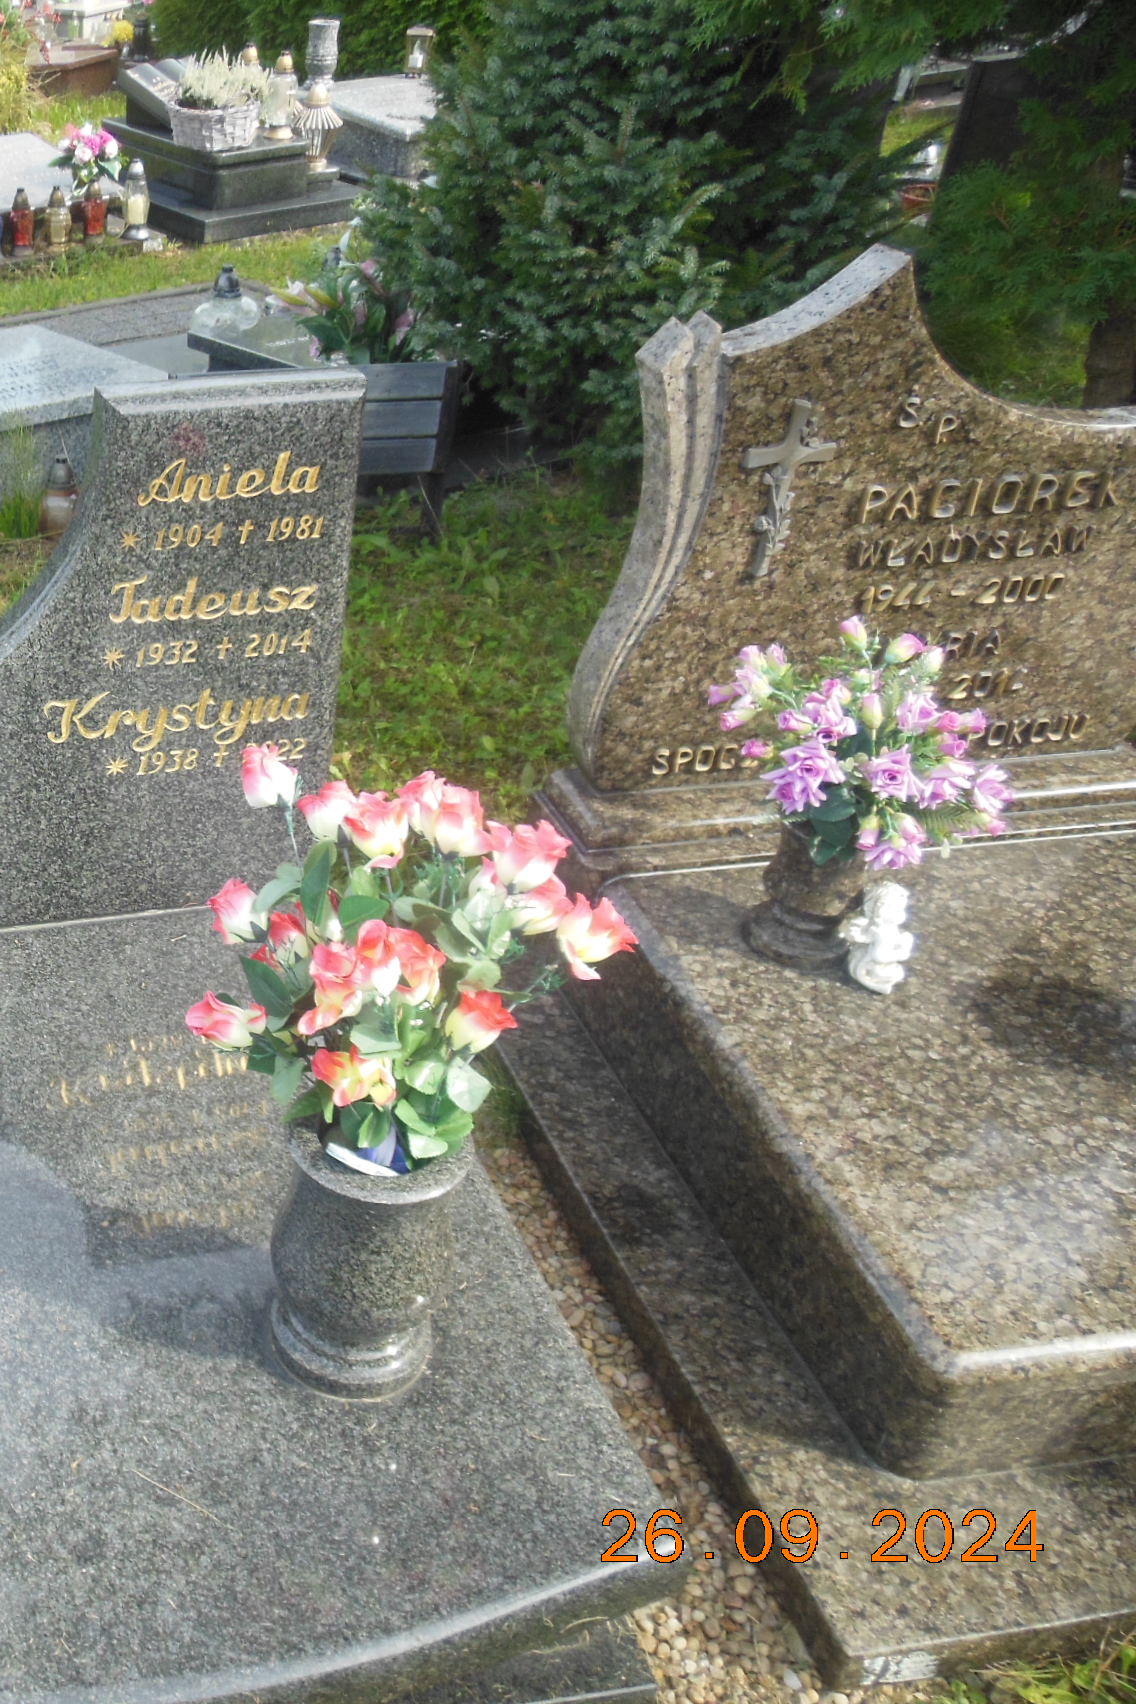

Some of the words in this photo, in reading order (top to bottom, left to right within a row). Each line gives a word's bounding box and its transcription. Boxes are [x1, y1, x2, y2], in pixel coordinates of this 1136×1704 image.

[137, 450, 321, 507] Aniela
[154, 521, 224, 551] 1904
[266, 513, 325, 542] 1981
[109, 574, 319, 624] Tadeusz
[134, 639, 200, 668] 1932
[245, 628, 313, 658] 2014
[43, 687, 311, 752] Krystyna
[136, 748, 199, 777] 1938
